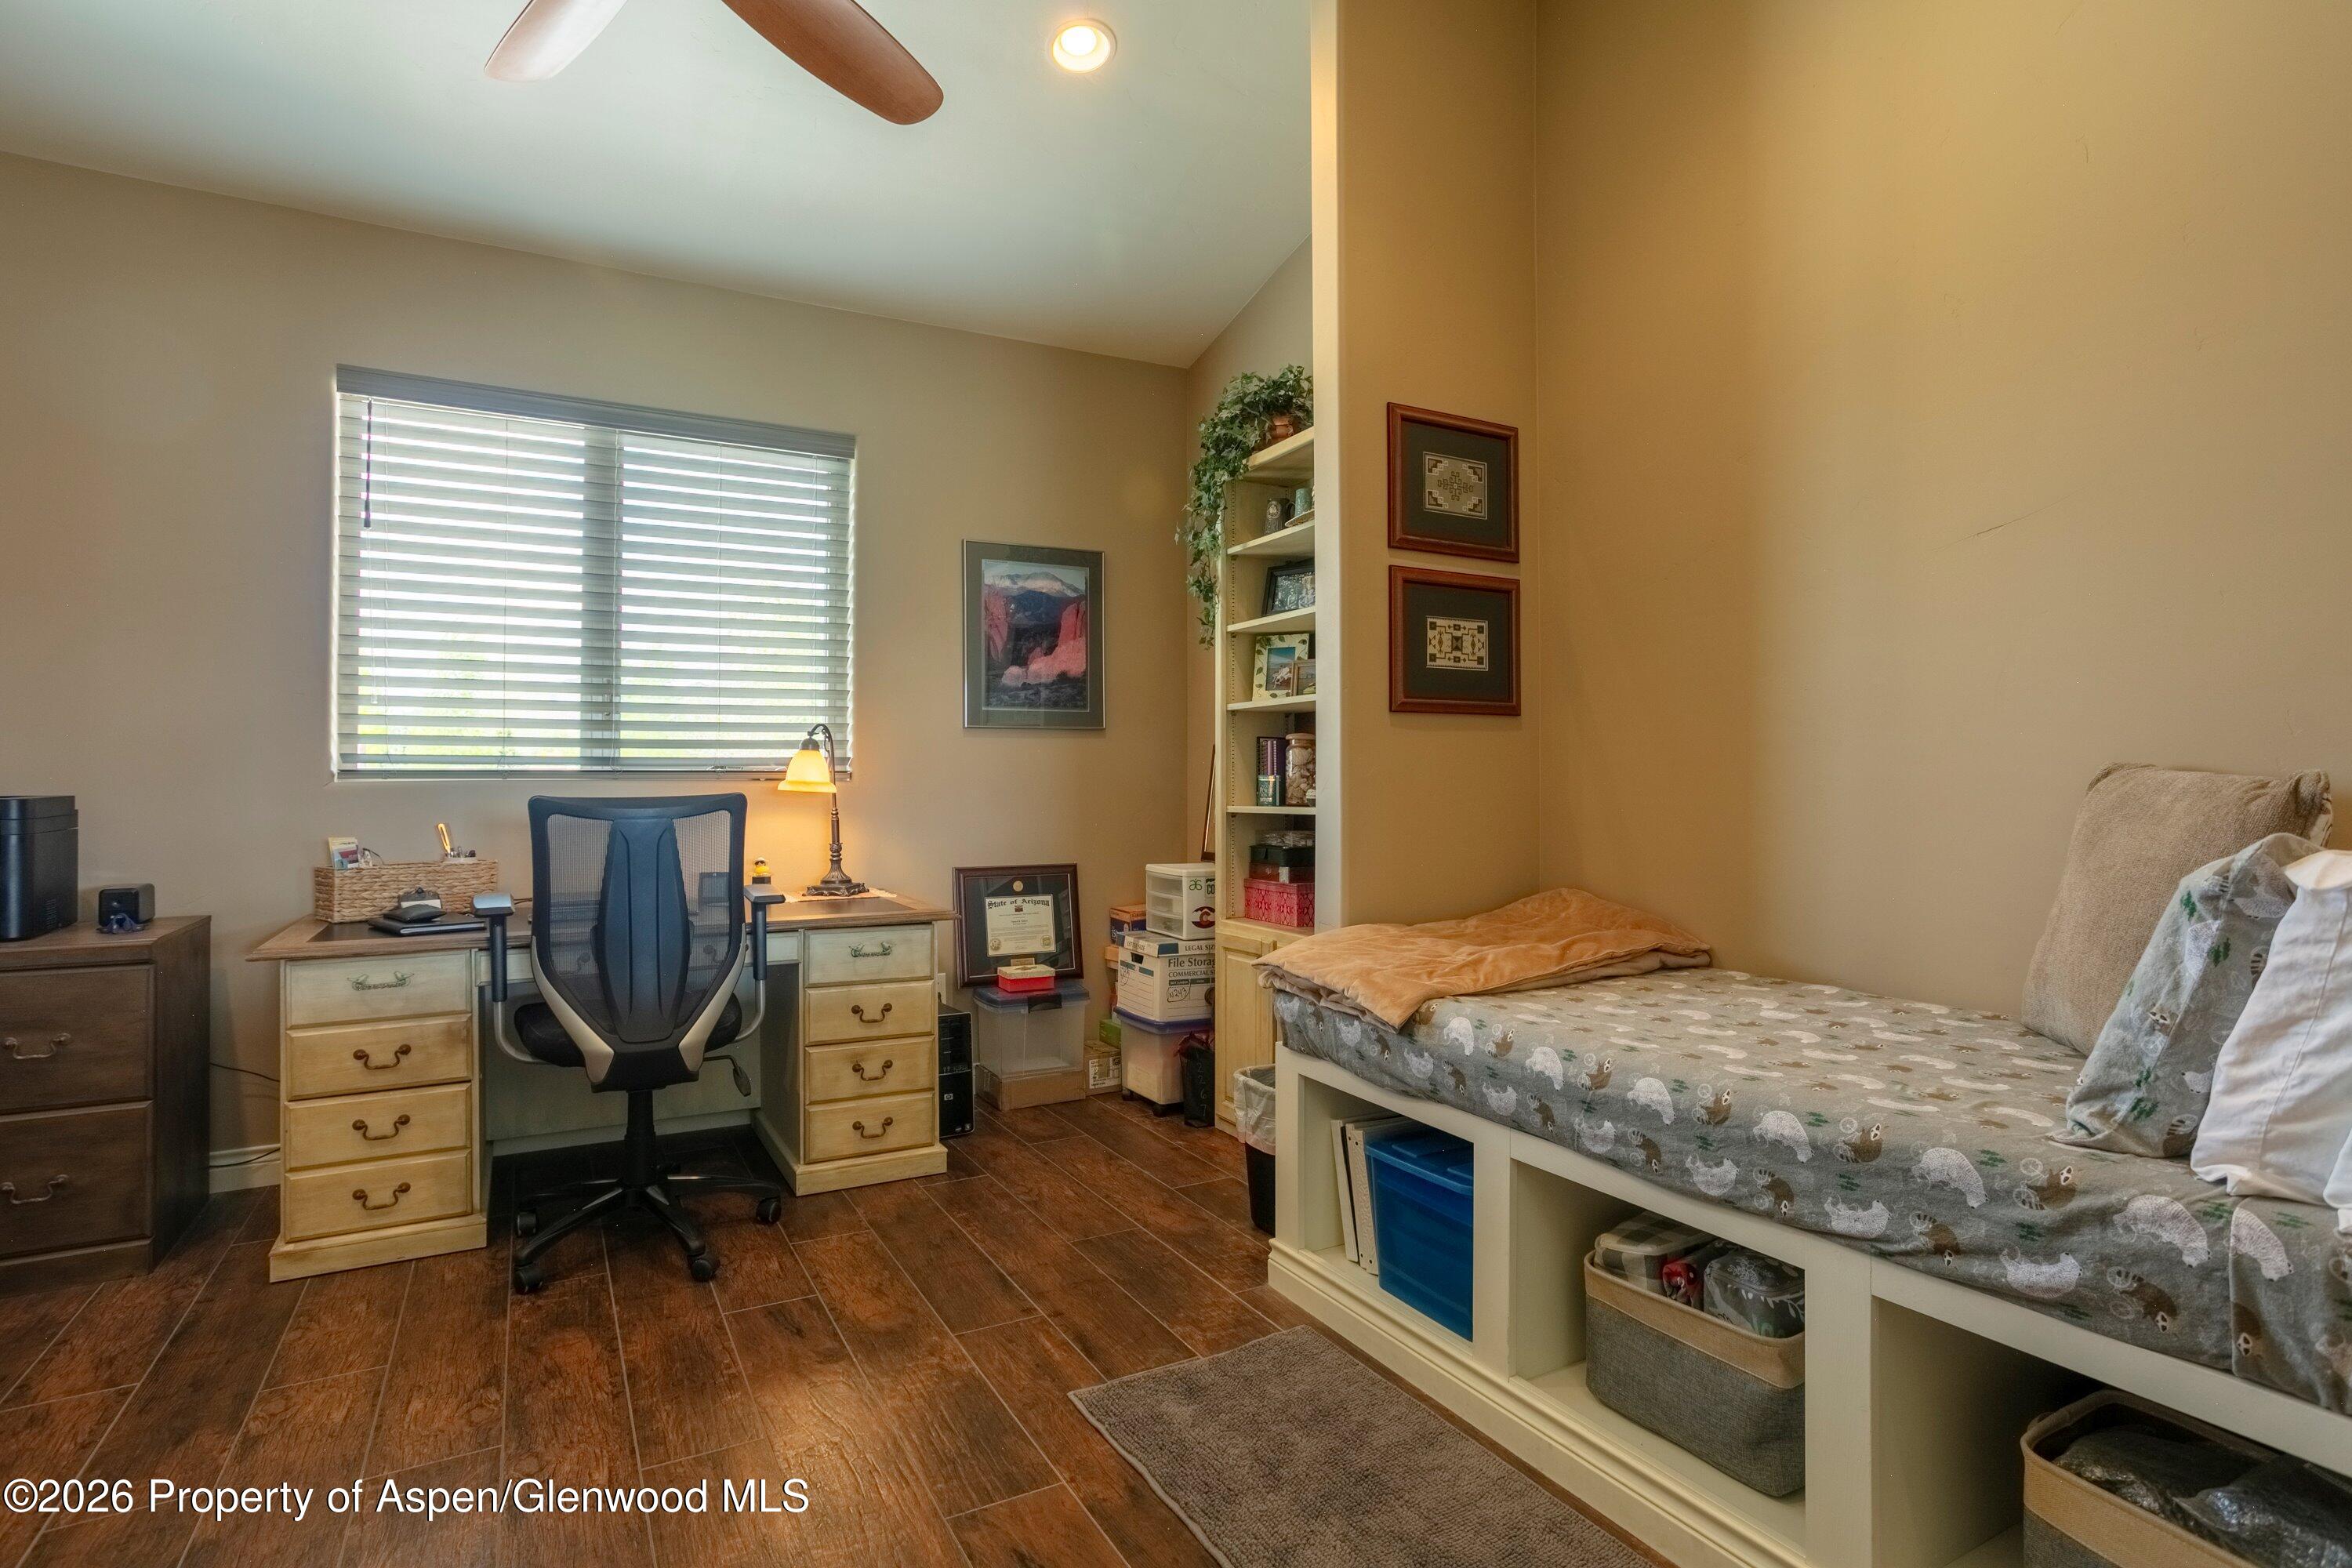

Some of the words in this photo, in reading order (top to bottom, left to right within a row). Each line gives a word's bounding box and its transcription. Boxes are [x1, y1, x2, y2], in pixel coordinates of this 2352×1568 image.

[987, 900, 1007, 909] State
[1168, 957, 1185, 967] File
[1187, 957, 1216, 969] Storag
